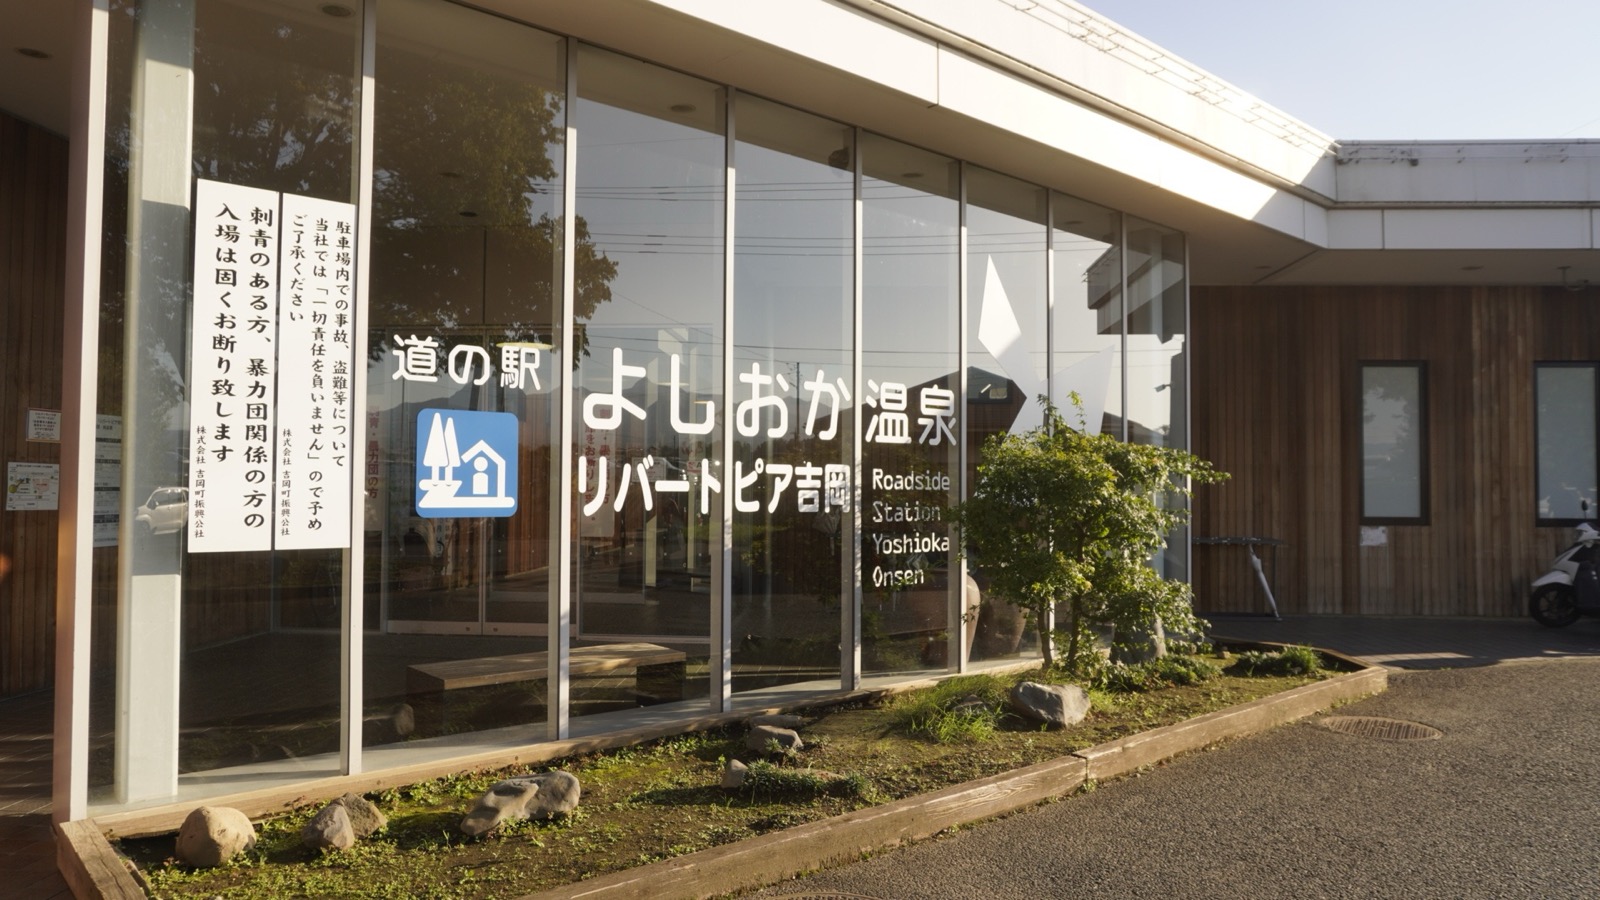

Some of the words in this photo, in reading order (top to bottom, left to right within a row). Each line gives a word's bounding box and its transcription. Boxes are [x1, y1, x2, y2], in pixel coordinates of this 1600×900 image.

[290, 214, 308, 322] ご了承ください
[211, 203, 241, 462] 入場は固くお断り致します
[243, 206, 273, 528] 刺青のある方、暴力団関係の方の
[332, 221, 352, 467] 駐車場内での事故、盗難等について
[392, 334, 541, 390] 道の駅
[307, 218, 329, 530] 当社では「一切責任を負いません」ので予め
[583, 347, 957, 446] よしおか温泉
[578, 454, 851, 517] リバートピア吉岡
[872, 468, 950, 490] Roadside
[872, 500, 941, 523] Station
[872, 531, 950, 555] Yoshioka
[872, 565, 924, 588] Onsen
